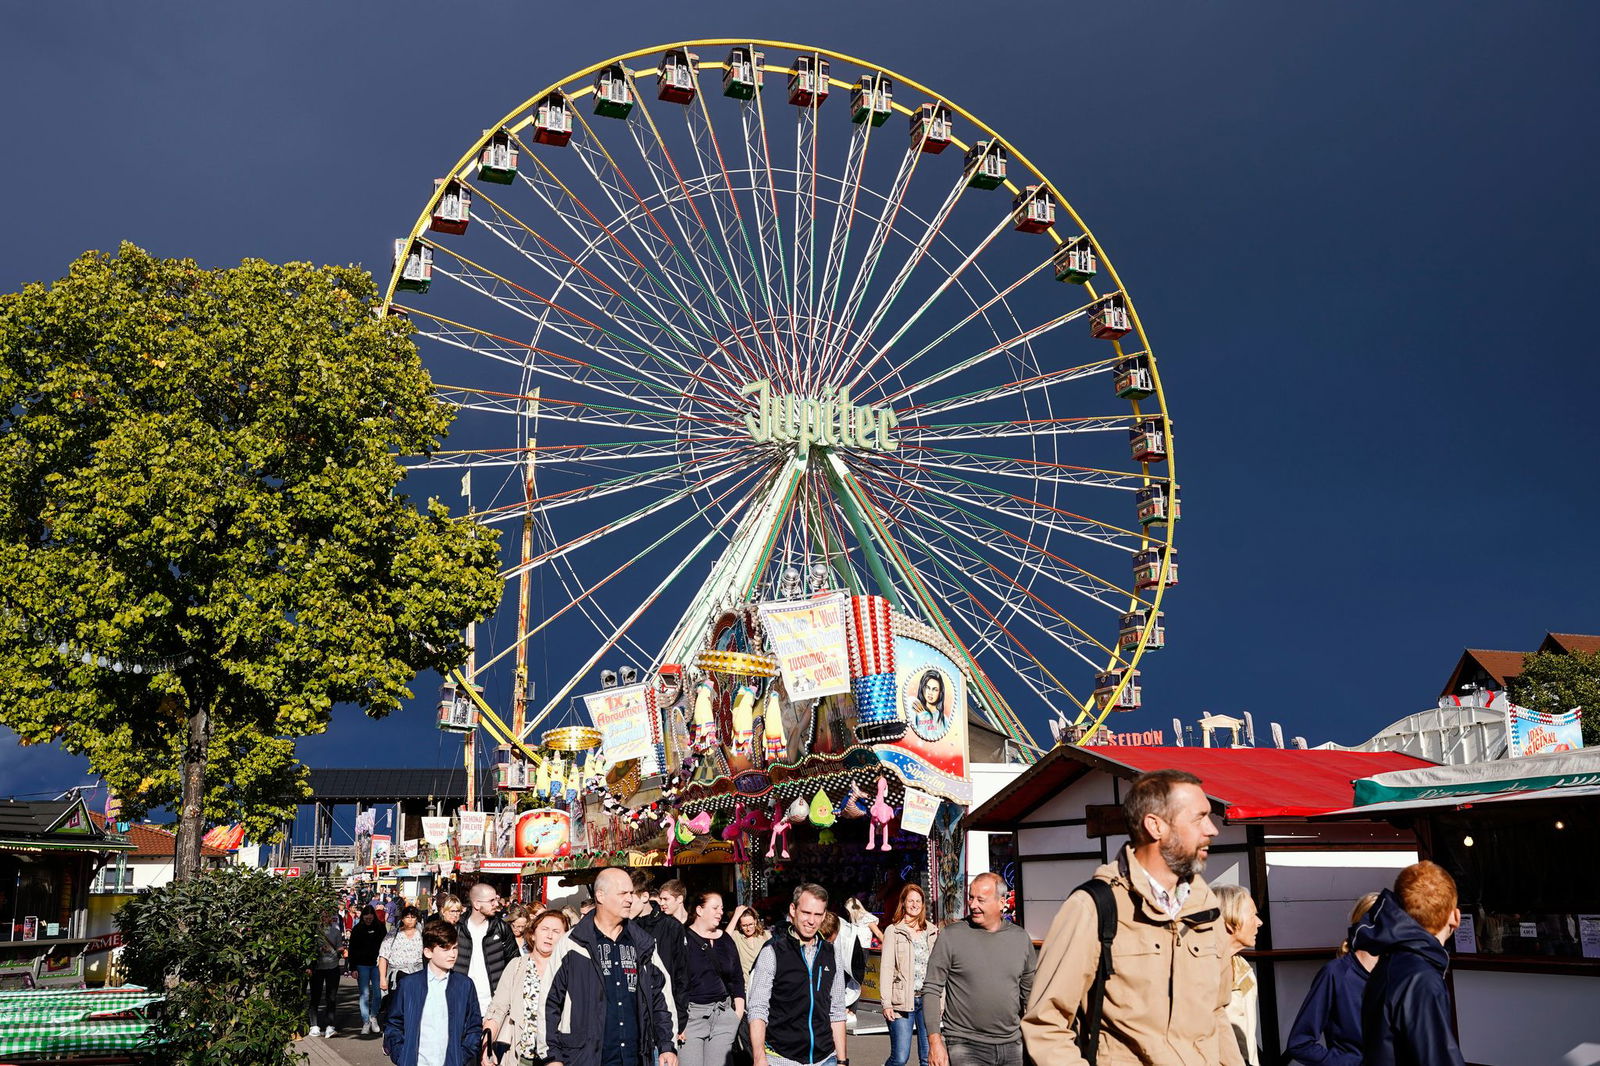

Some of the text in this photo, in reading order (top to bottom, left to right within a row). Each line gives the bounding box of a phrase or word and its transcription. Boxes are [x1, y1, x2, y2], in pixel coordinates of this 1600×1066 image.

[741, 378, 899, 455] Jupiter
[605, 695, 624, 711] 1x
[1108, 731, 1163, 747] SEIDON
[1529, 726, 1544, 743] DAS
